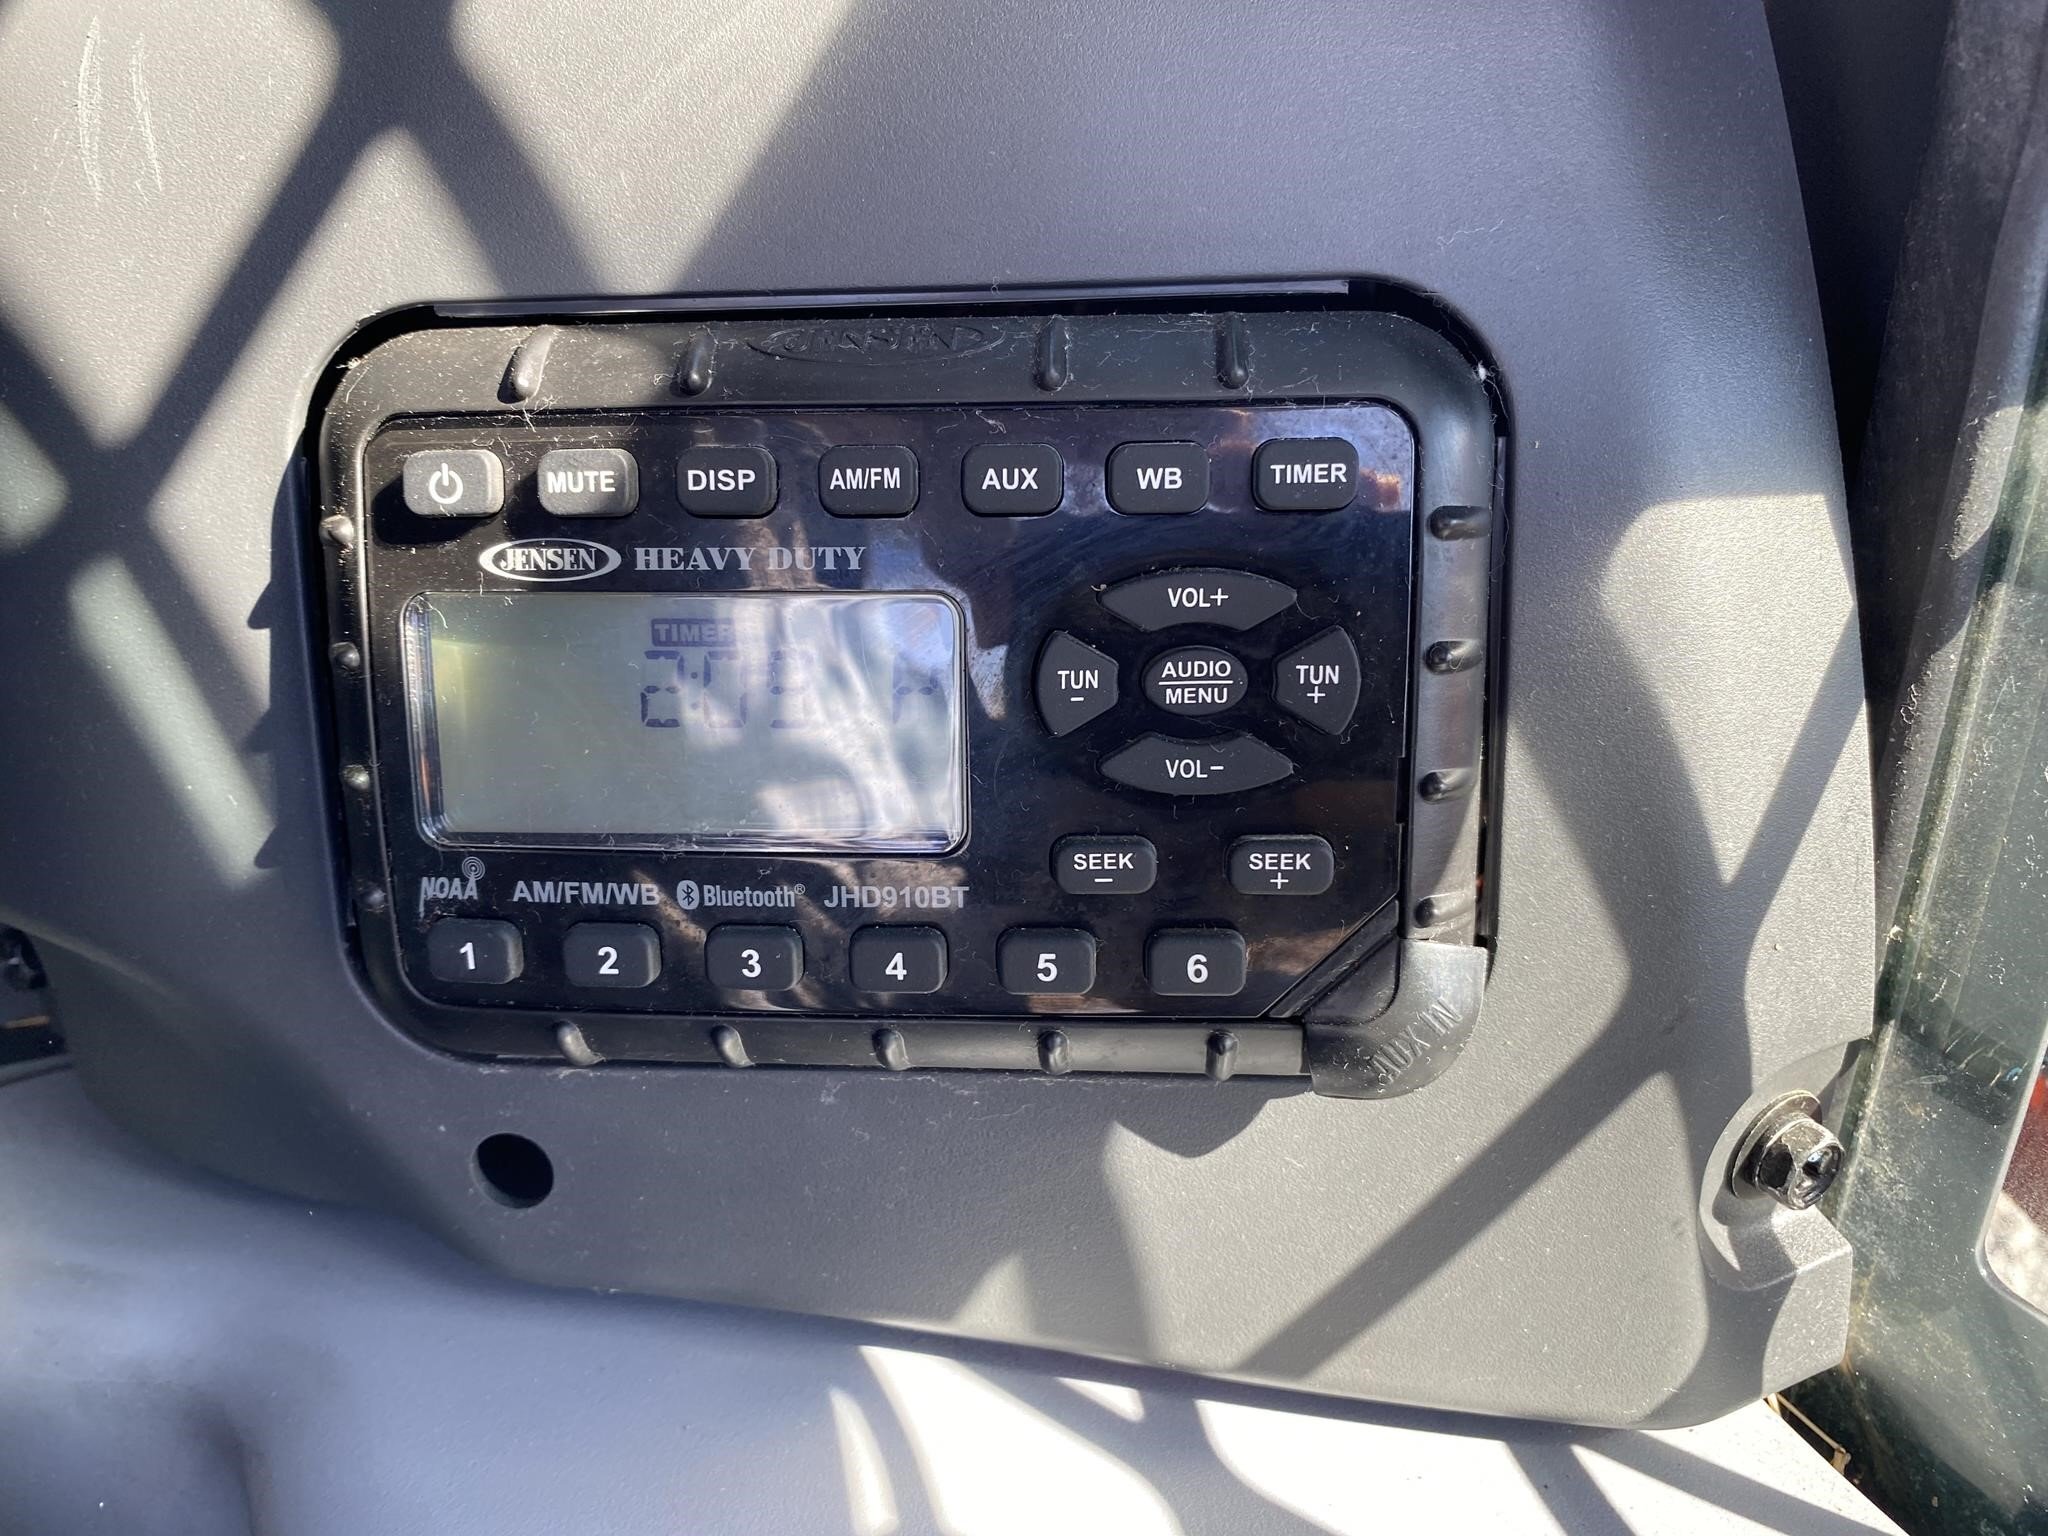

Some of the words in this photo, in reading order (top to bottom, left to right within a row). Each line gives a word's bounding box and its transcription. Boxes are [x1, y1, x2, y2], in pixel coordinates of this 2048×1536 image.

[547, 471, 616, 493] MUTE
[687, 470, 756, 491] DISP
[829, 467, 901, 490] AM/FM
[981, 467, 1039, 490] AUX
[1136, 467, 1183, 490] WB
[1270, 463, 1347, 484] TIMER
[499, 547, 597, 572] JENSEN
[634, 546, 755, 571] HEAVY
[767, 546, 867, 571] DUTY
[1167, 587, 1229, 608] VOL+
[1057, 669, 1098, 689] TUN
[1161, 660, 1231, 679] AUDIO
[1296, 665, 1339, 685] TUN
[1165, 686, 1228, 704] MENU
[1165, 759, 1224, 778] VOL-
[1073, 853, 1134, 870] SEEK
[1248, 853, 1311, 870] SEEK
[512, 880, 660, 905] AM/FM/WB
[823, 885, 969, 909] JHD910BT
[459, 942, 476, 970] 1
[598, 947, 619, 975] 2
[741, 949, 762, 977] 3
[885, 953, 907, 981] 4
[1036, 953, 1058, 982] 5
[1186, 954, 1209, 984] 6
[1370, 1026, 1431, 1083] AUX
[1416, 996, 1462, 1036] IN
